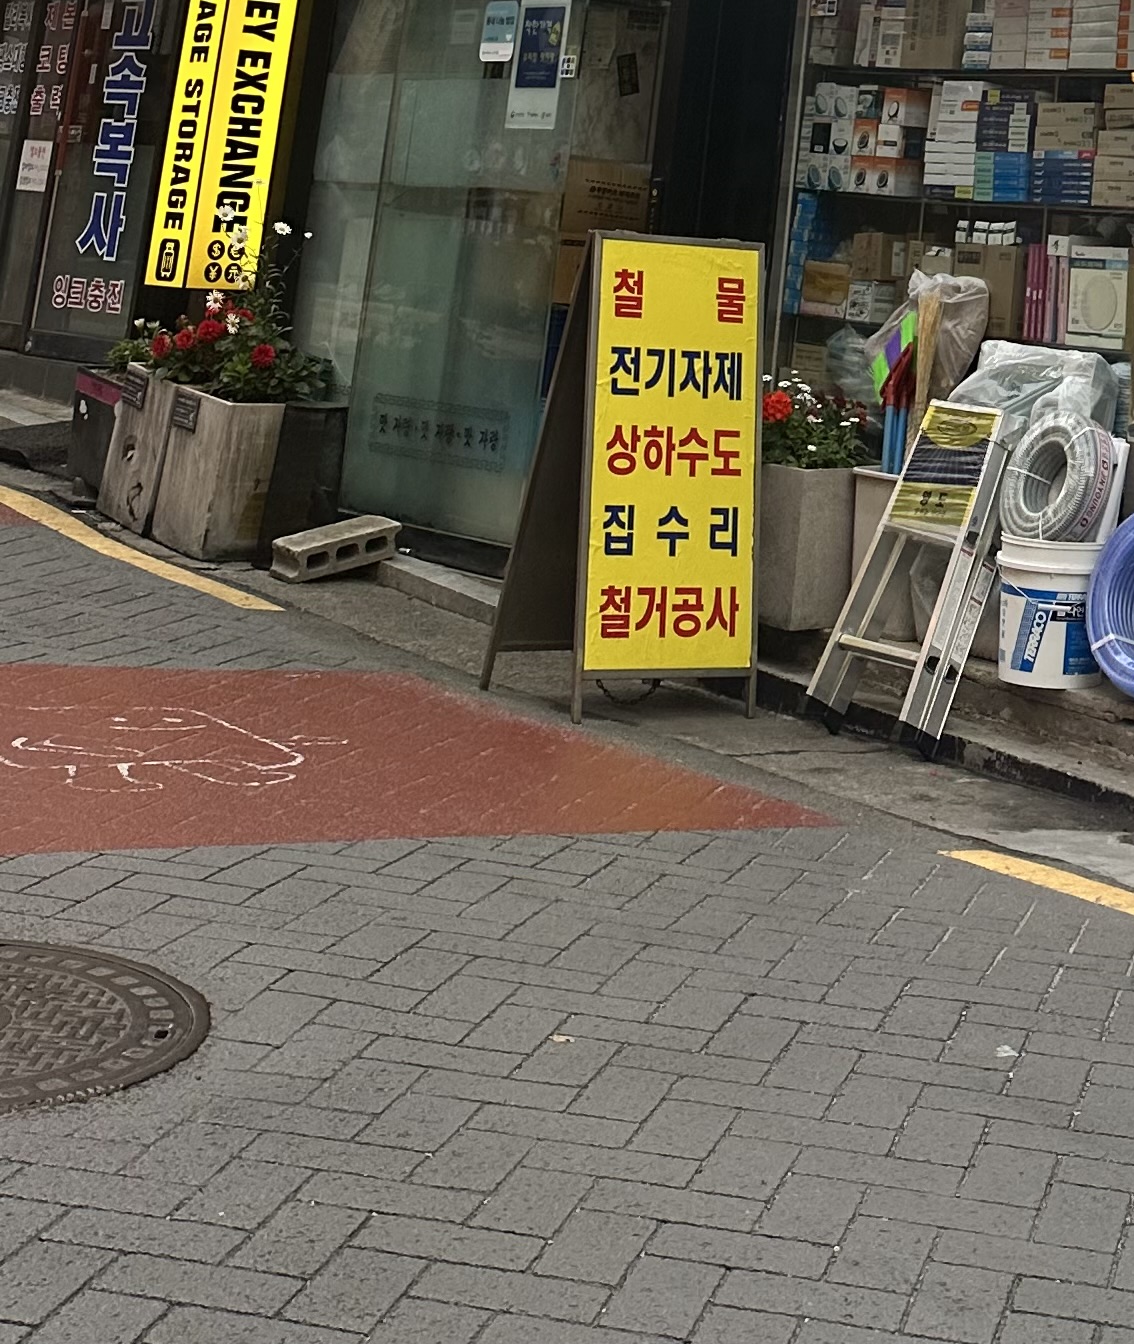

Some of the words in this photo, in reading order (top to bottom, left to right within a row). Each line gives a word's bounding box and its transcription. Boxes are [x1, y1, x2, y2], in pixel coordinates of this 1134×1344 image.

[164, 78, 203, 230] STORAGE
[212, 49, 269, 234] EXCHANGE
[52, 274, 125, 314] 잉크충전
[605, 423, 741, 478] 상하수도
[599, 585, 739, 639] 철거공사
[1023, 611, 1047, 663] TERRACO
